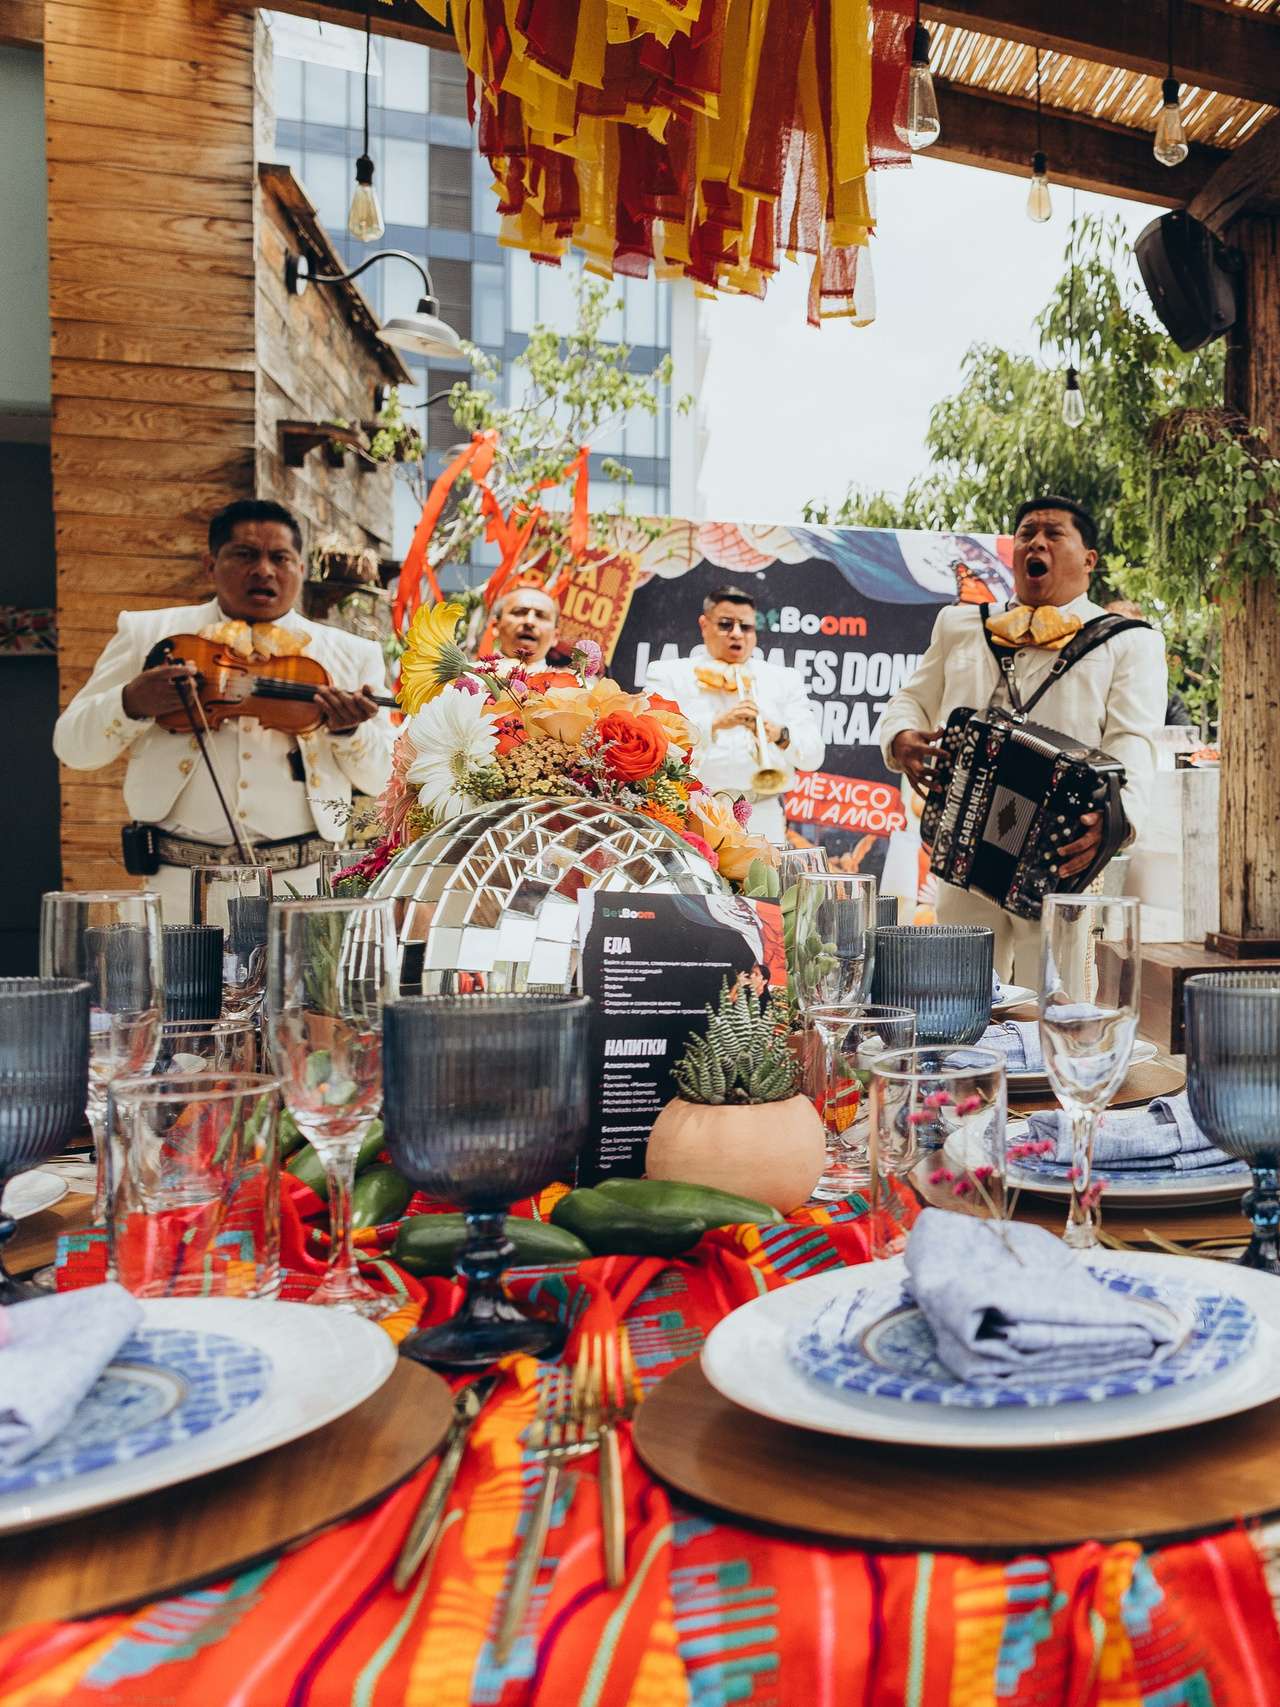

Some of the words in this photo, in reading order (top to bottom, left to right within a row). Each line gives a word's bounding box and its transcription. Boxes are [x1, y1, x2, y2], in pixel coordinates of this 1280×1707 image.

[793, 771, 891, 810] MÉXICO
[785, 796, 815, 820] MI
[820, 803, 905, 832] AMOR
[957, 766, 989, 847] GABBANELLI
[603, 936, 632, 955] ЕДА
[604, 1039, 667, 1056] НАПИТКИ
[601, 1125, 654, 1133] Безалкогольны
